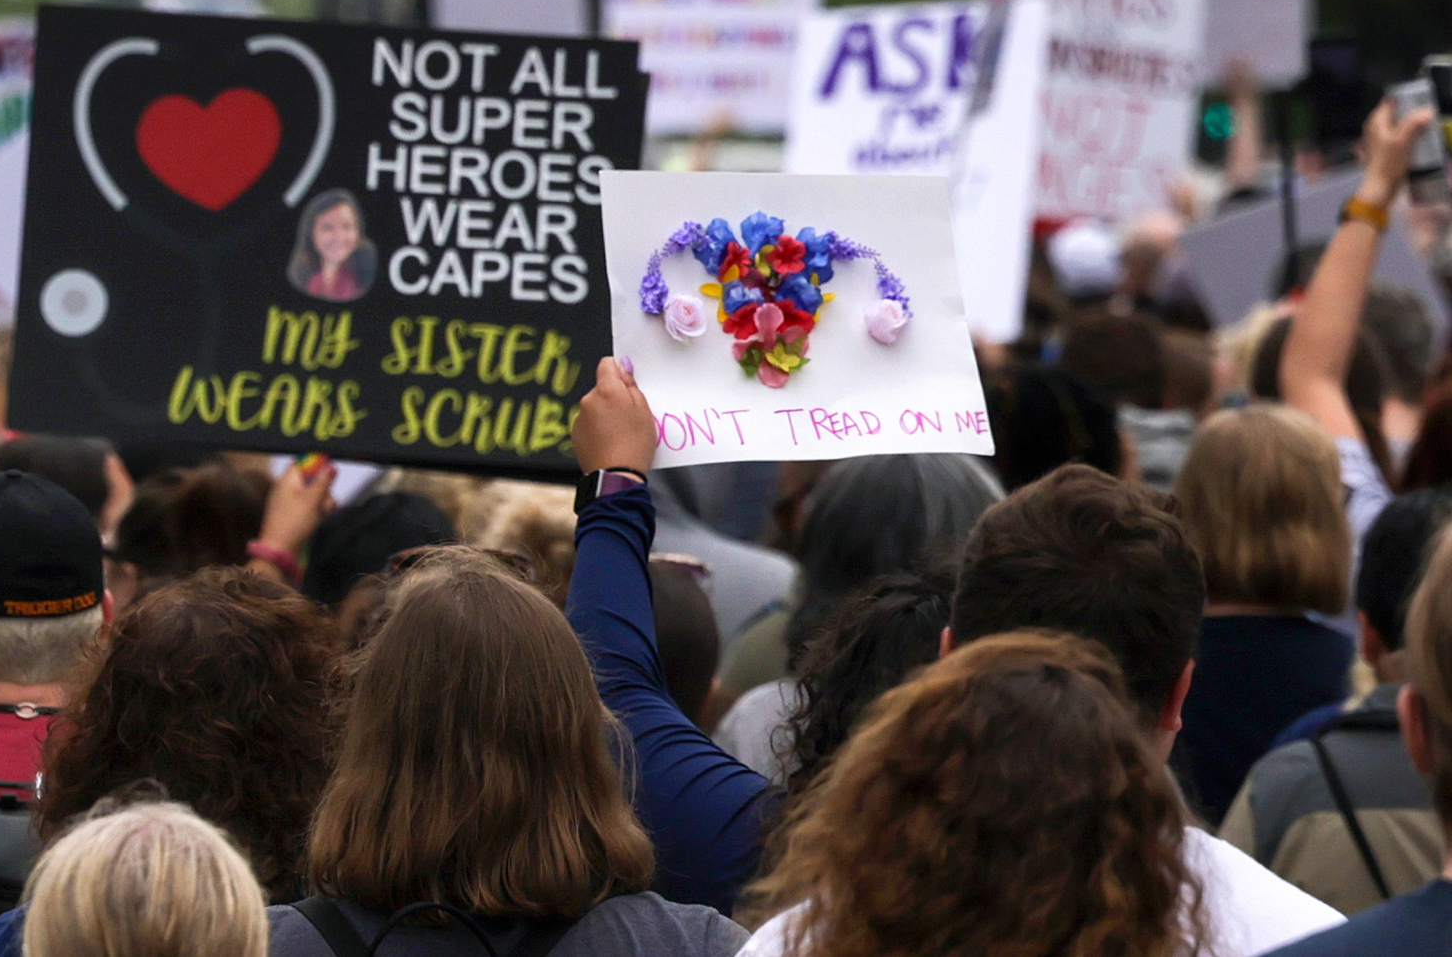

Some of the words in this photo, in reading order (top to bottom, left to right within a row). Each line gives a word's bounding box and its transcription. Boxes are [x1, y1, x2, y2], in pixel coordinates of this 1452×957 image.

[371, 39, 498, 92] NOT
[510, 48, 619, 100] ALL
[389, 92, 595, 152] SUPER
[365, 142, 614, 206] HEROES
[399, 197, 578, 254] WEAR
[388, 245, 589, 305] CAPES
[381, 315, 582, 397] SISTER
[167, 364, 366, 442] WEARS
[653, 408, 749, 452] ON'T
[774, 406, 882, 446] TREAD
[898, 408, 943, 436] ON
[954, 410, 989, 436] ME
